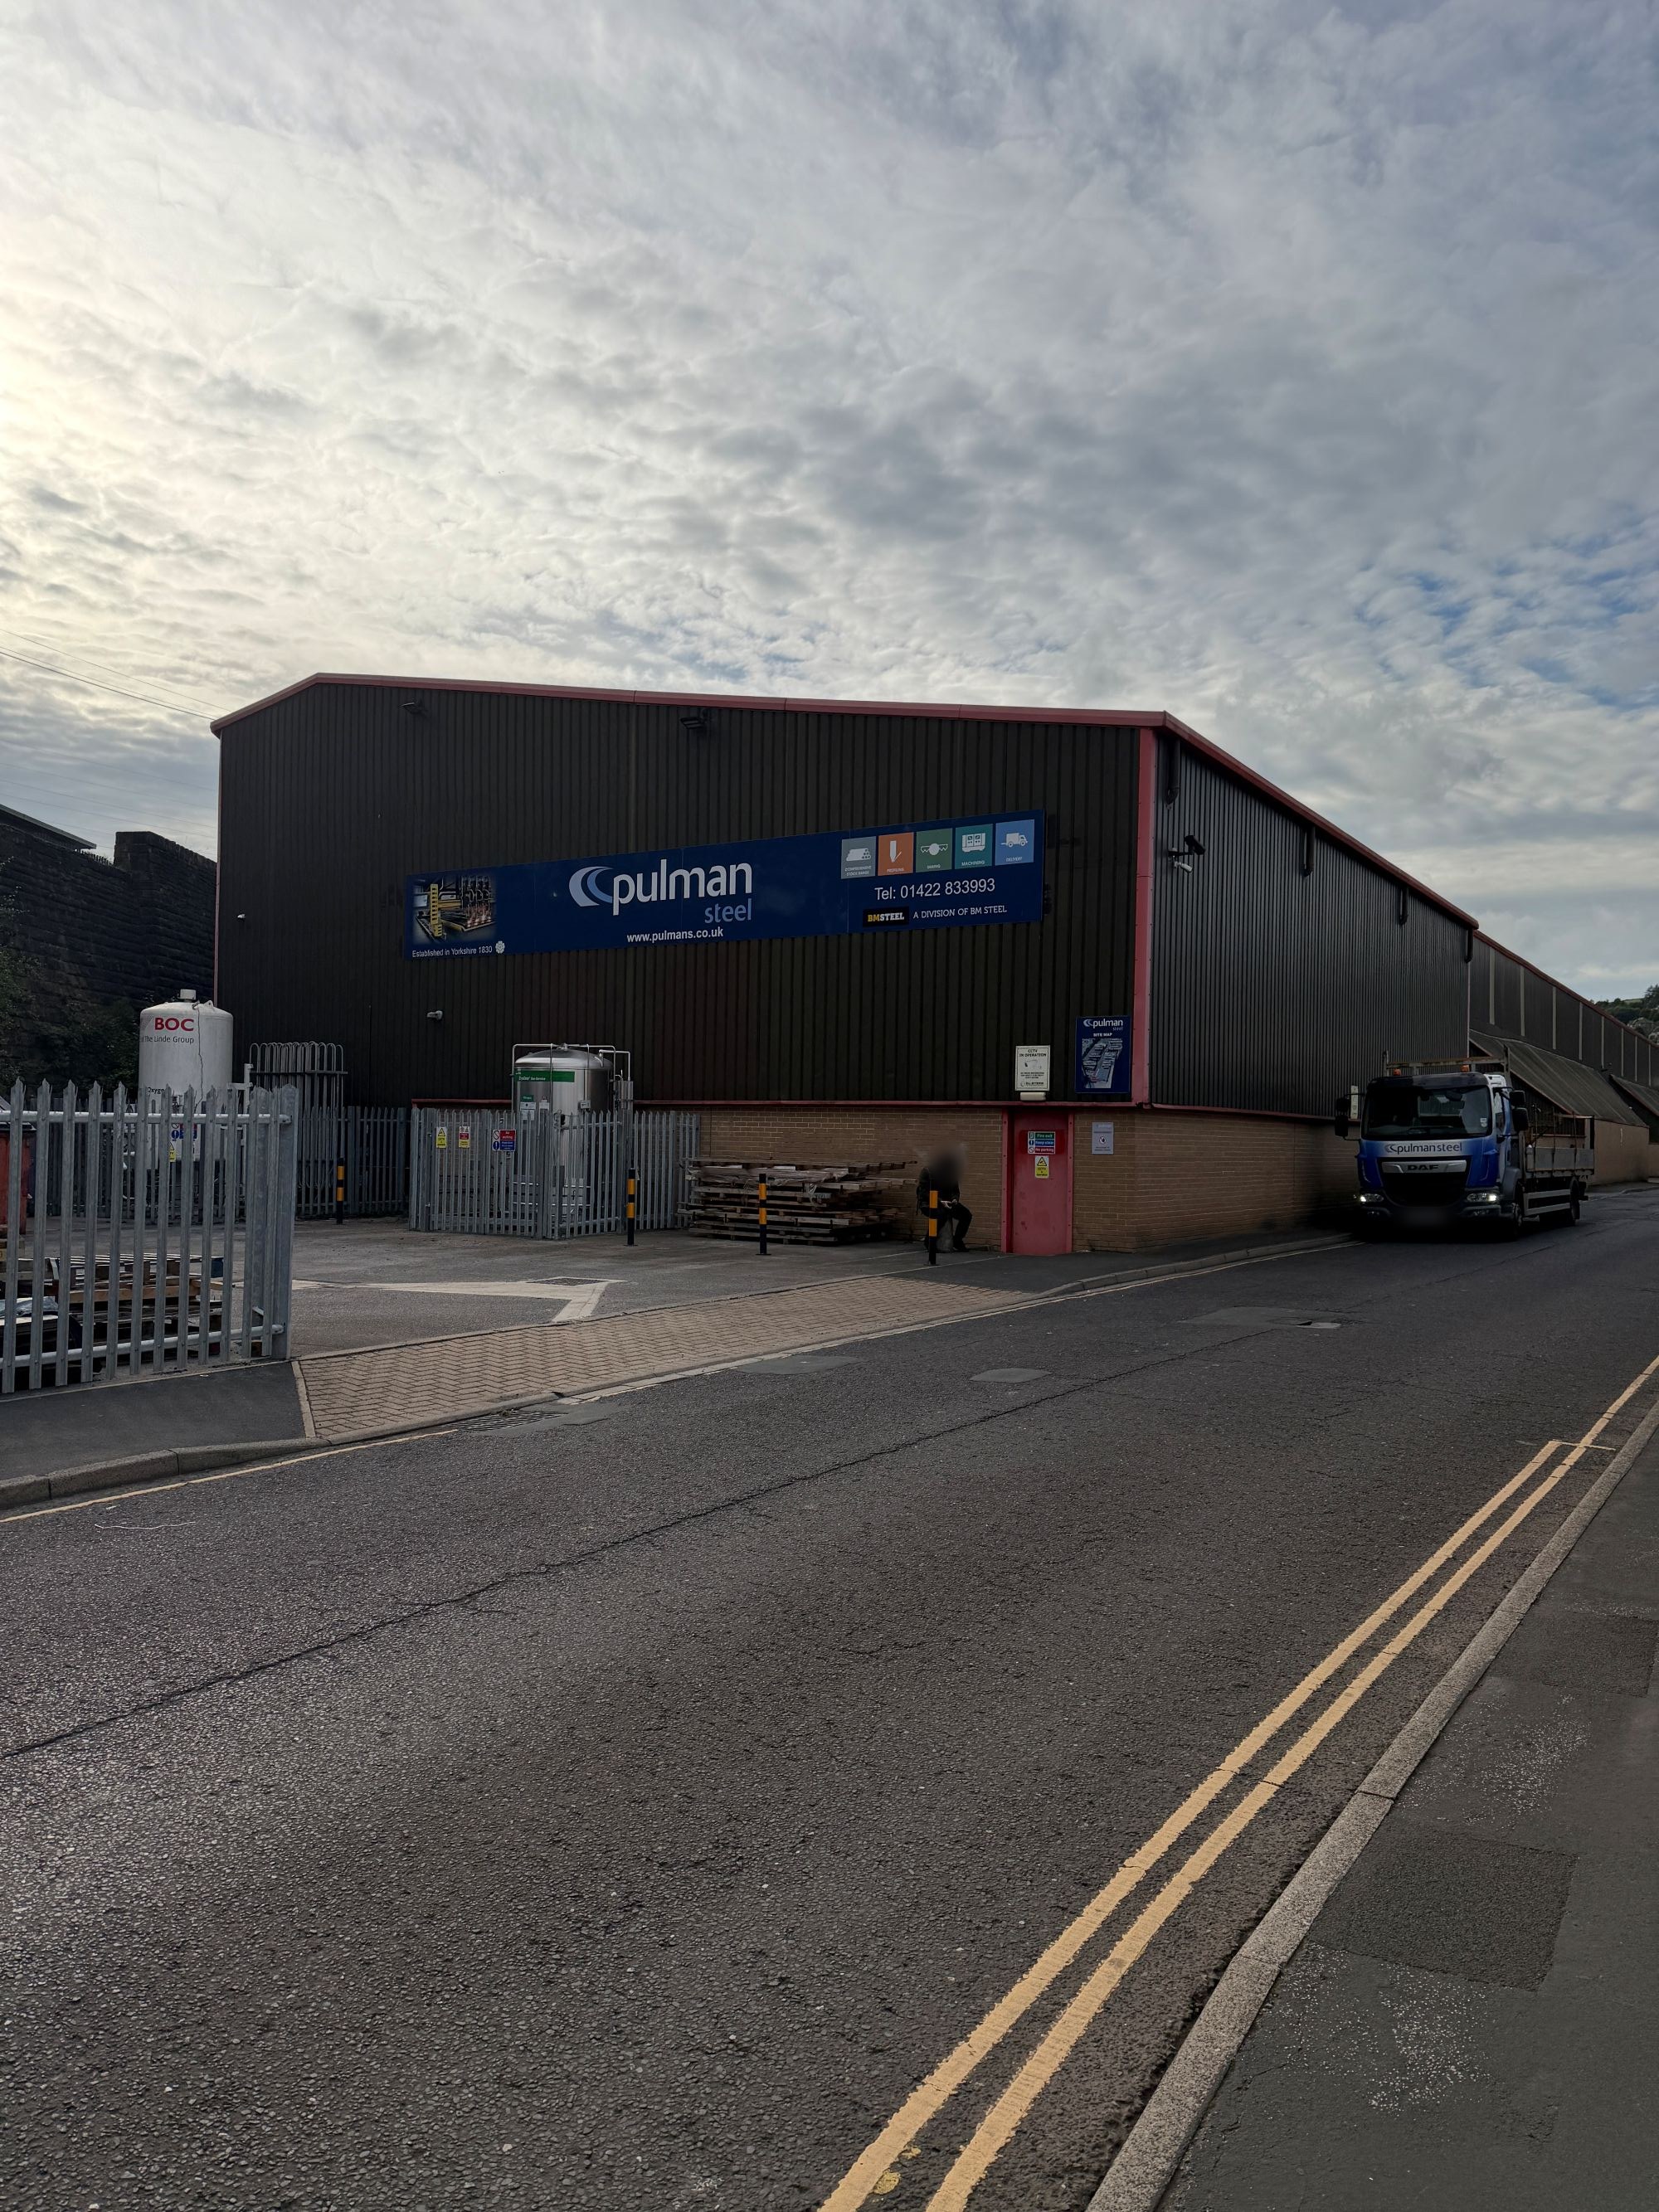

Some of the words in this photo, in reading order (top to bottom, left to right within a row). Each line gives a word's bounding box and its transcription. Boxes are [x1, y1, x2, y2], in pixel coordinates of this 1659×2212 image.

[613, 858, 752, 916] pulman
[874, 887, 896, 900] Tel:
[900, 882, 941, 898] 01422
[945, 878, 995, 895] 833993
[704, 898, 752, 924] steel
[921, 909, 956, 918] DIVISION
[970, 907, 982, 916] BM
[984, 905, 1007, 914] STEEL
[626, 926, 723, 944] www.pulmans.co.uk
[411, 949, 444, 958] Established
[450, 947, 477, 955] Yorkshire
[479, 946, 493, 954] 1830
[154, 1017, 194, 1032] BOC
[1093, 1018, 1123, 1028] pulman
[173, 1036, 194, 1044] Group
